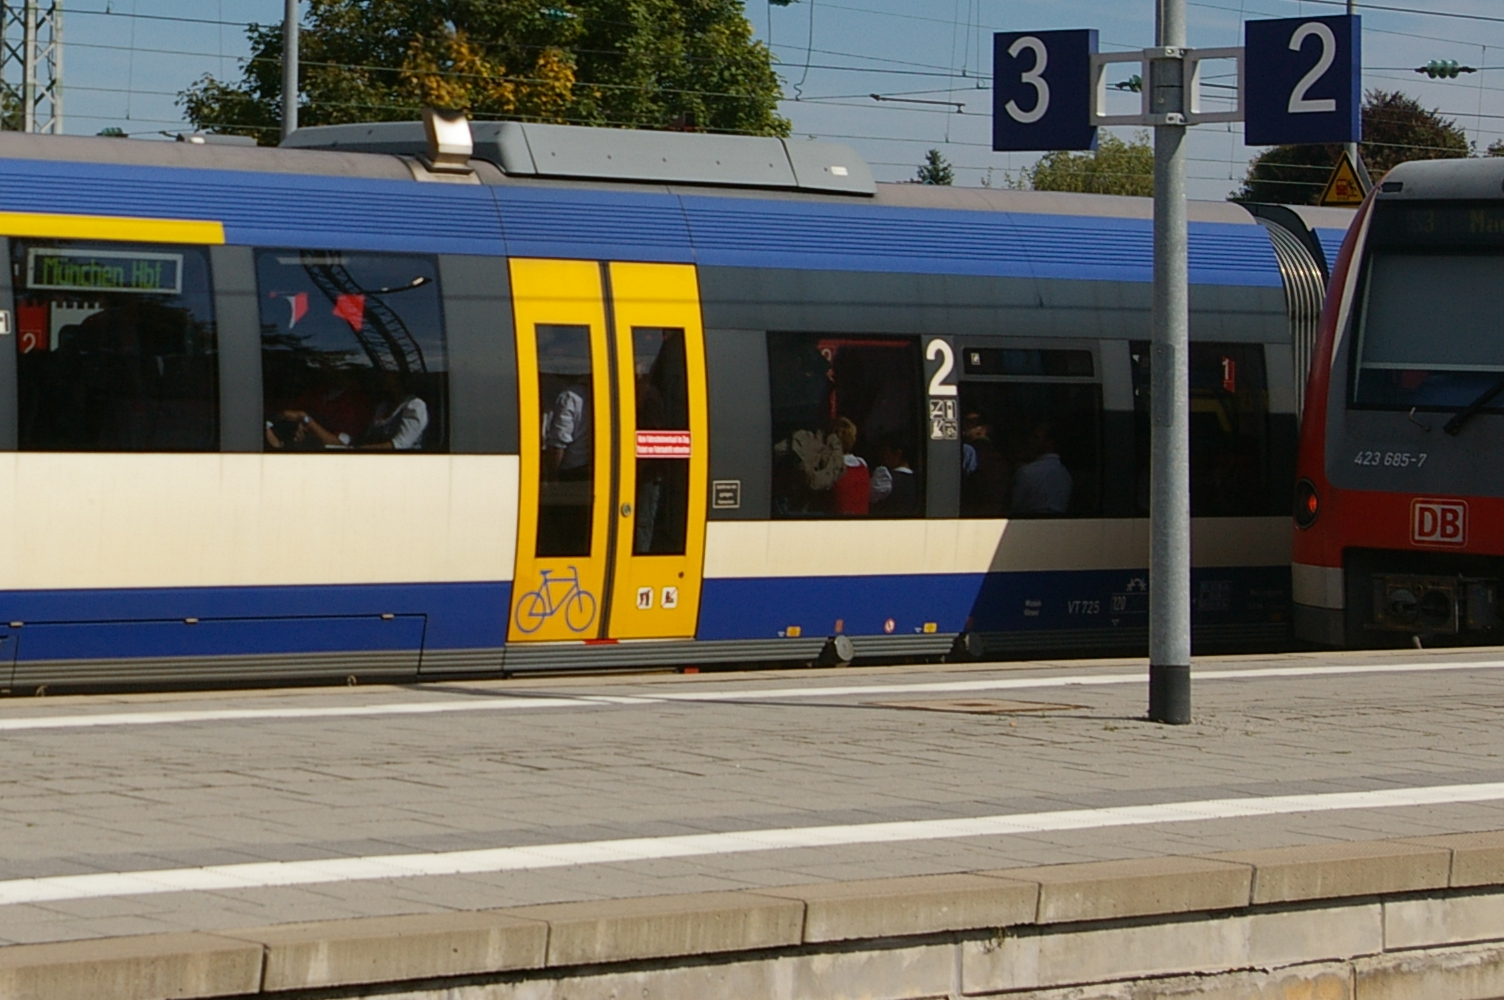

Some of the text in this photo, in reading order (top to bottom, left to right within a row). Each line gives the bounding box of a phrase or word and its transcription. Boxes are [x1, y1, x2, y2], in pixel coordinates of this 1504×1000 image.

[1004, 36, 1050, 124] 3
[1288, 22, 1337, 113] 2
[1470, 209, 1504, 233] Ma
[43, 257, 163, 289] München Hbf
[926, 339, 958, 396] 2
[1354, 451, 1427, 467] 423 685-7
[1418, 506, 1460, 539] DB
